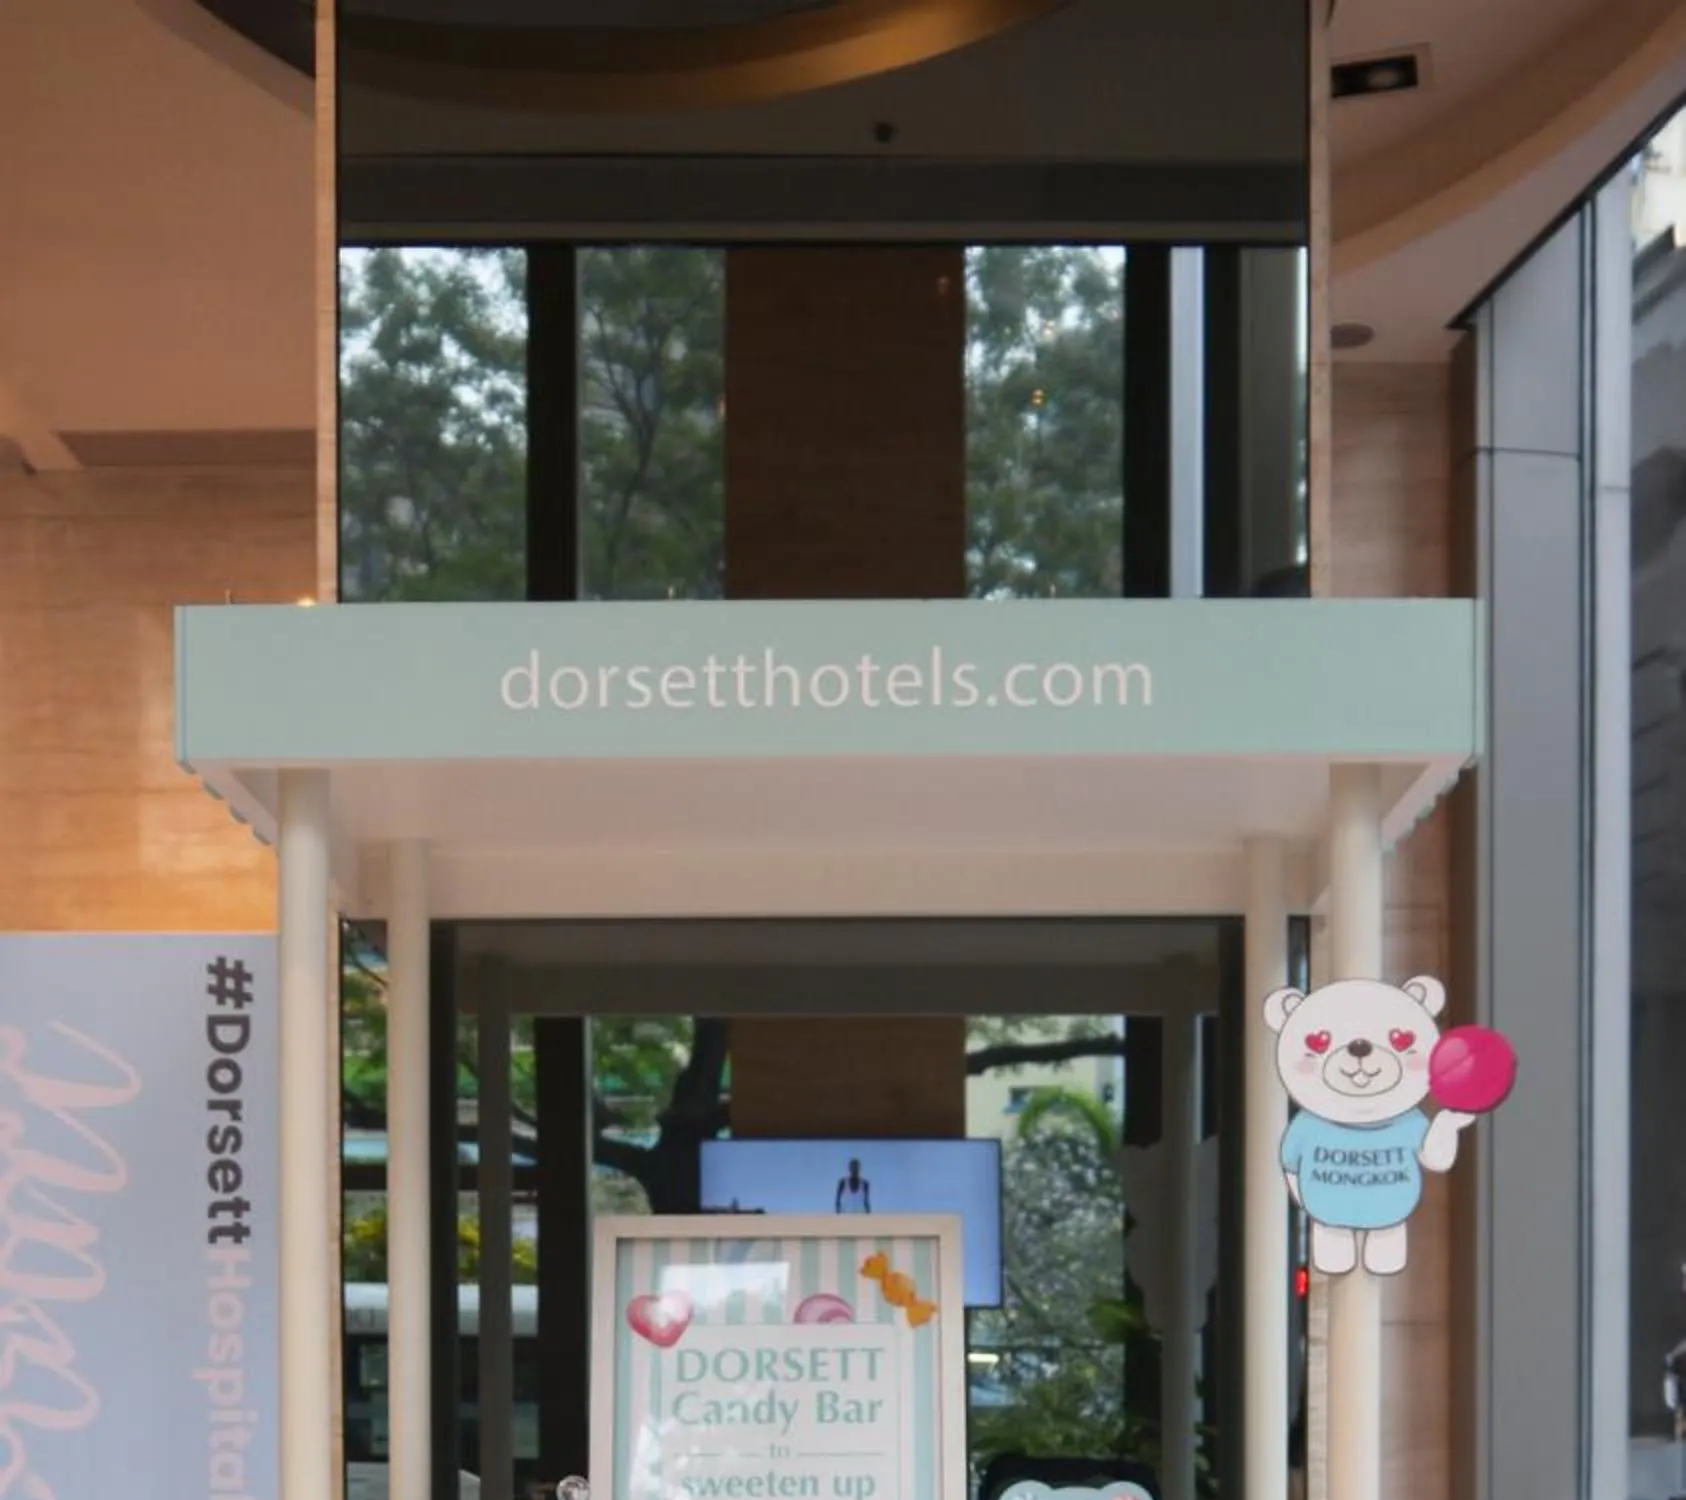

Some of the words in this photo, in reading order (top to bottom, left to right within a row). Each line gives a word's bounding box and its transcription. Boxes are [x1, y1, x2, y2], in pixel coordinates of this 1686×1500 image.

[499, 646, 1155, 711] dorsetthotels.com
[1313, 1145, 1406, 1166] DORSETT
[1310, 1167, 1411, 1187] MONGKOK
[676, 1346, 885, 1382] DORSETT
[672, 1391, 800, 1436] Candy
[815, 1391, 883, 1424] Bar
[769, 1442, 791, 1459] to
[681, 1468, 819, 1498] sweeten
